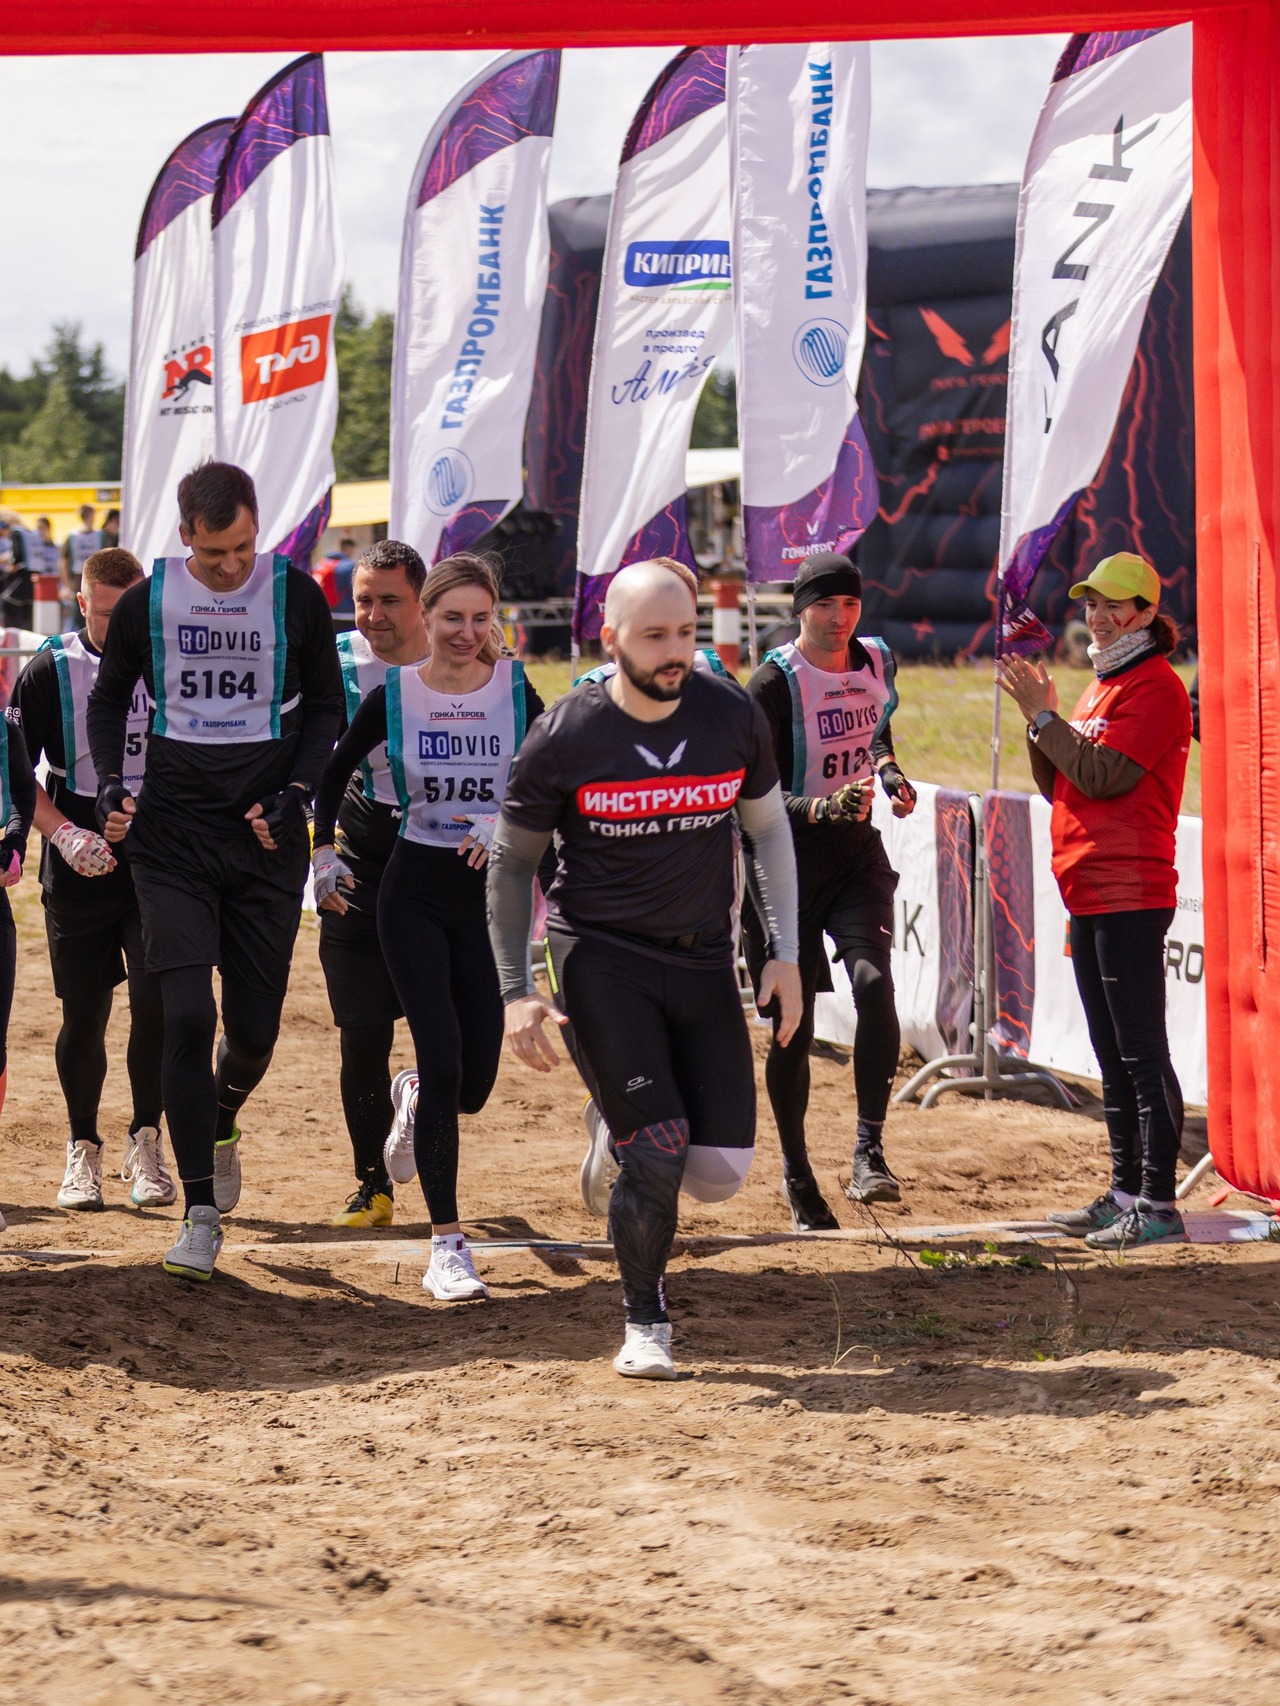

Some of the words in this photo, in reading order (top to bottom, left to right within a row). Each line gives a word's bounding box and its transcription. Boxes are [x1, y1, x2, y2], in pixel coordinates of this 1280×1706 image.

[805, 61, 833, 299] ГАЗПРОМБАНК
[1041, 113, 1161, 434] ANK
[441, 203, 506, 430] ГАЗПРОМБАНК
[191, 605, 216, 613] ГОНКА
[181, 628, 261, 653] RODVIG
[180, 669, 257, 700] 5164
[202, 719, 247, 729] ГАЗПРОМБАНК
[430, 711, 455, 719] ГОНКА
[457, 710, 486, 718] ГЕРОЕВ
[819, 704, 878, 737] RODVIG
[421, 734, 500, 758] RODVIG
[423, 776, 495, 804] 5165
[584, 778, 742, 813] ИНСТРУКТОР
[589, 820, 661, 837] ГОНКА
[667, 811, 730, 832] ГЕРО
